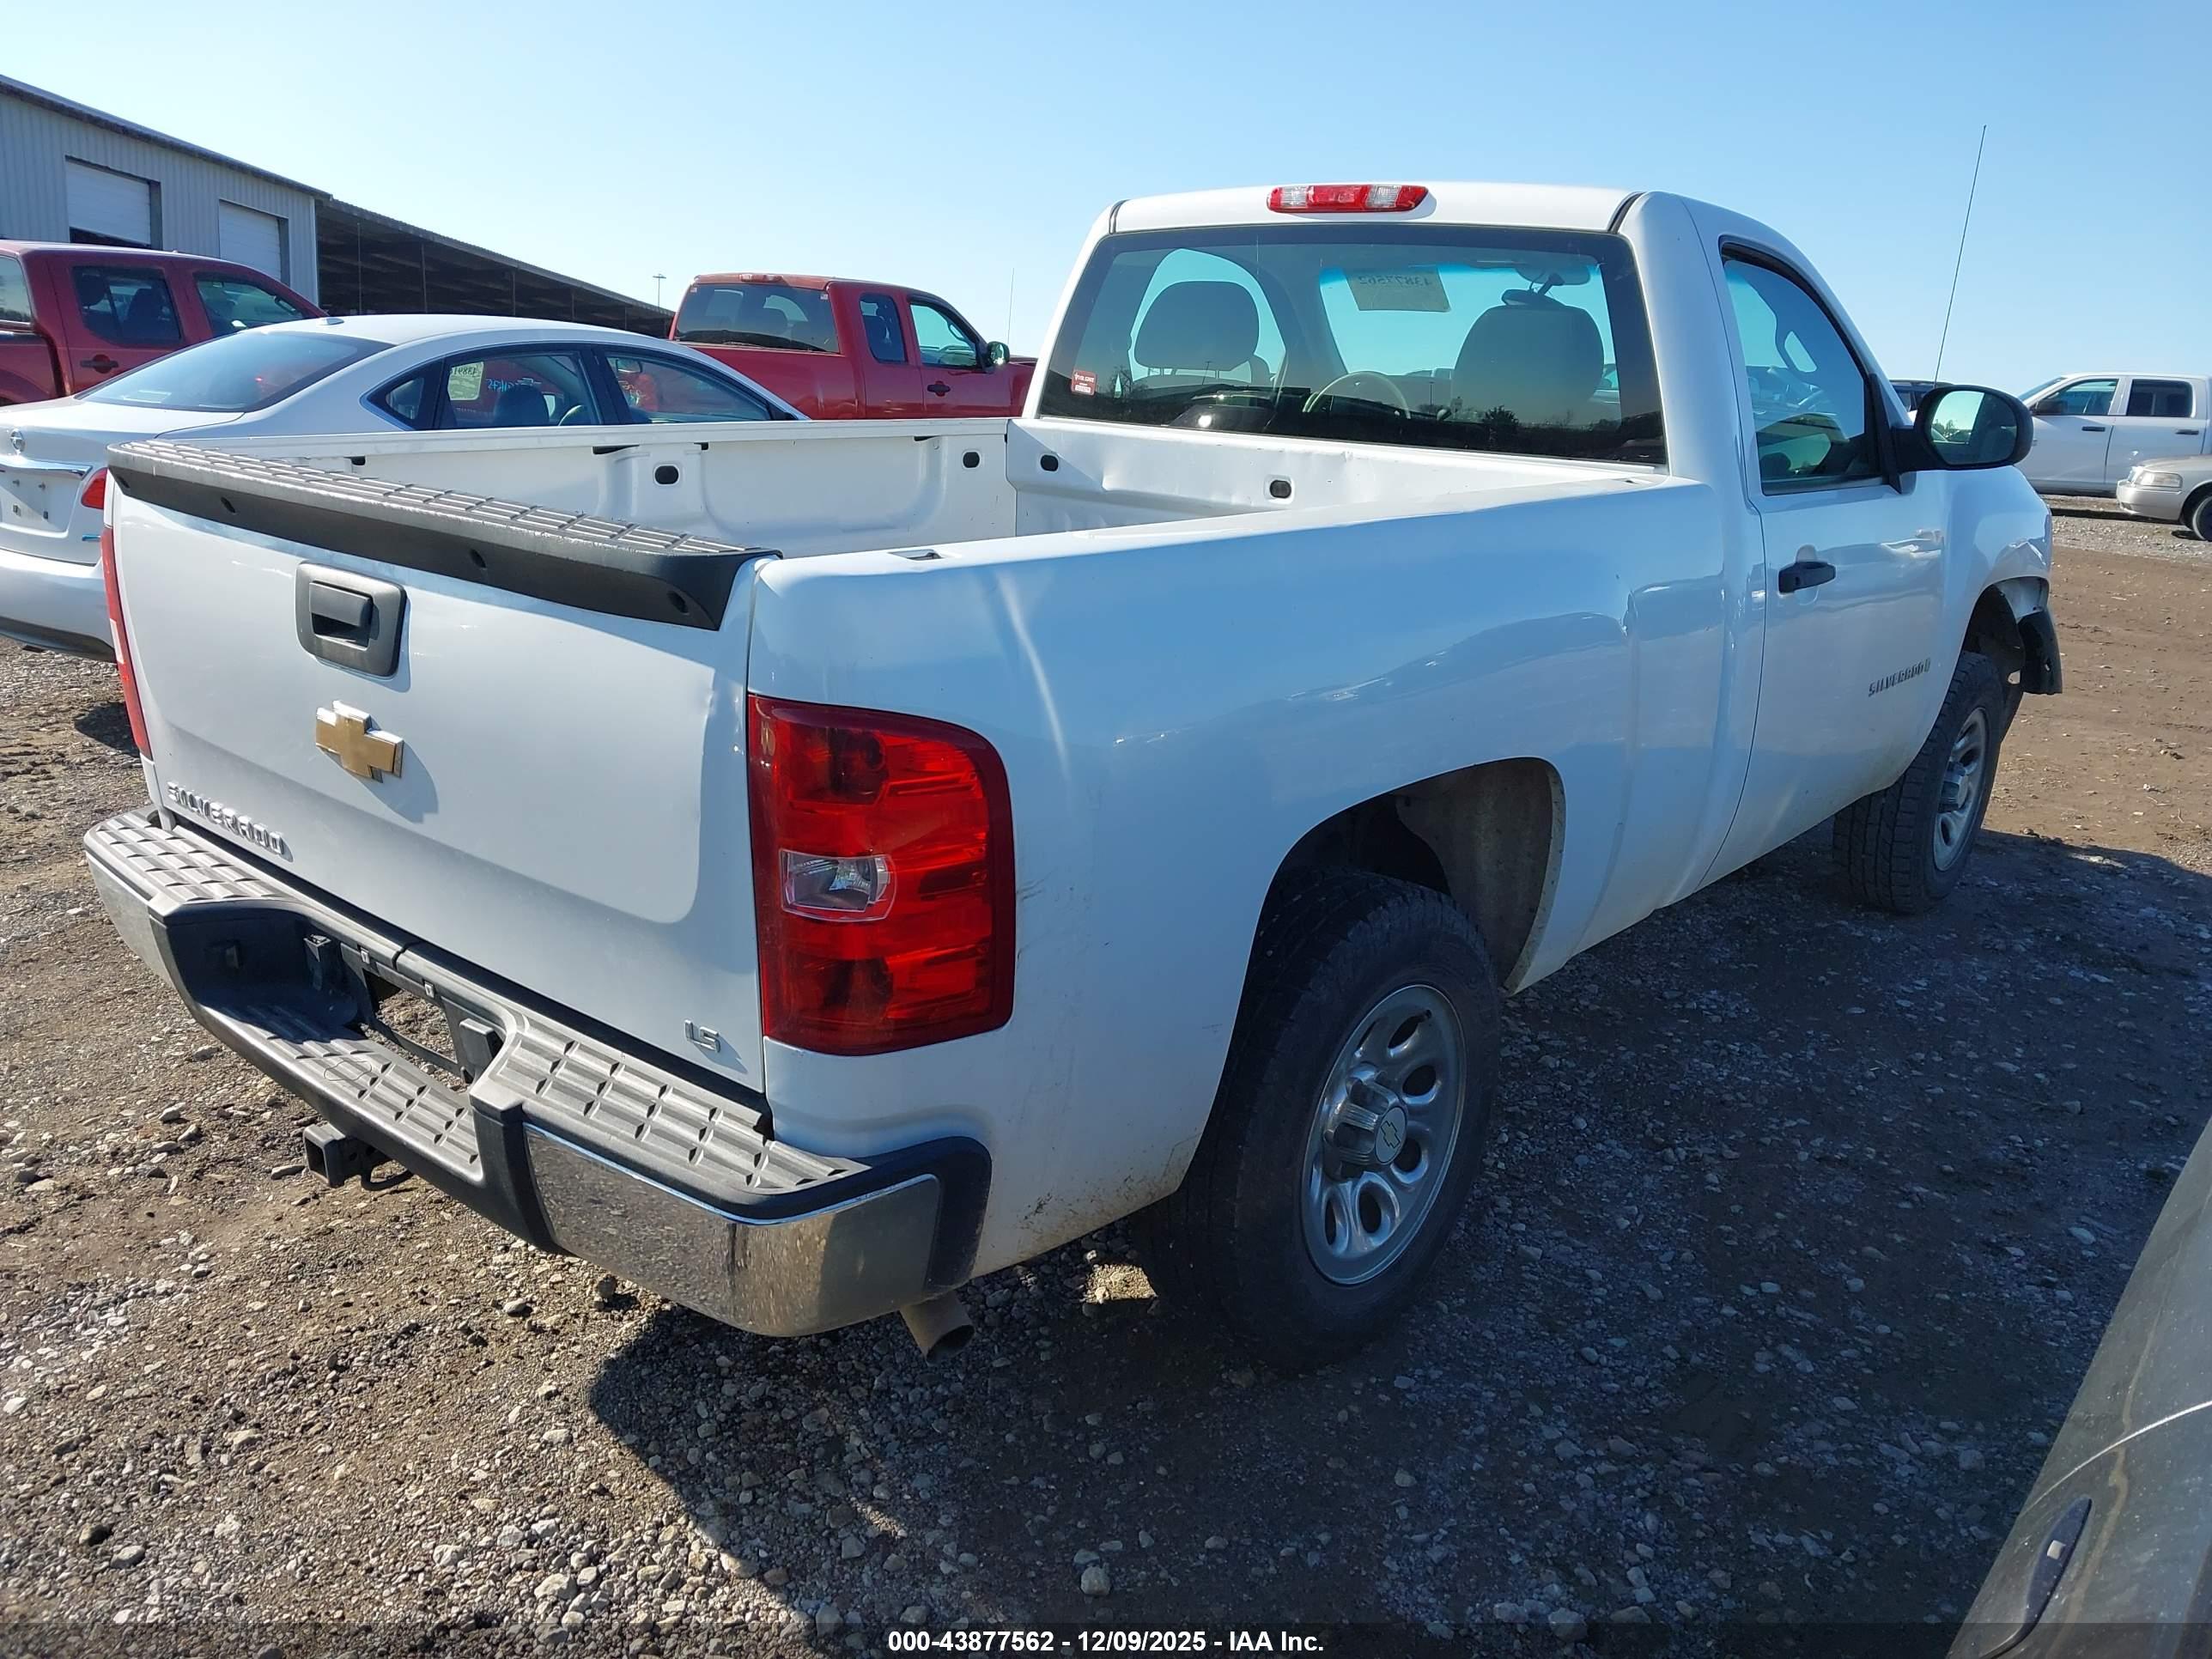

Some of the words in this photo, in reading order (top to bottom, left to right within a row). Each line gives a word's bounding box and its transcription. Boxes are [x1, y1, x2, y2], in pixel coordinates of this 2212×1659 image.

[1869, 658, 1930, 697] SILVERADO
[167, 781, 286, 855] SILVERADO
[684, 1019, 720, 1053] LS
